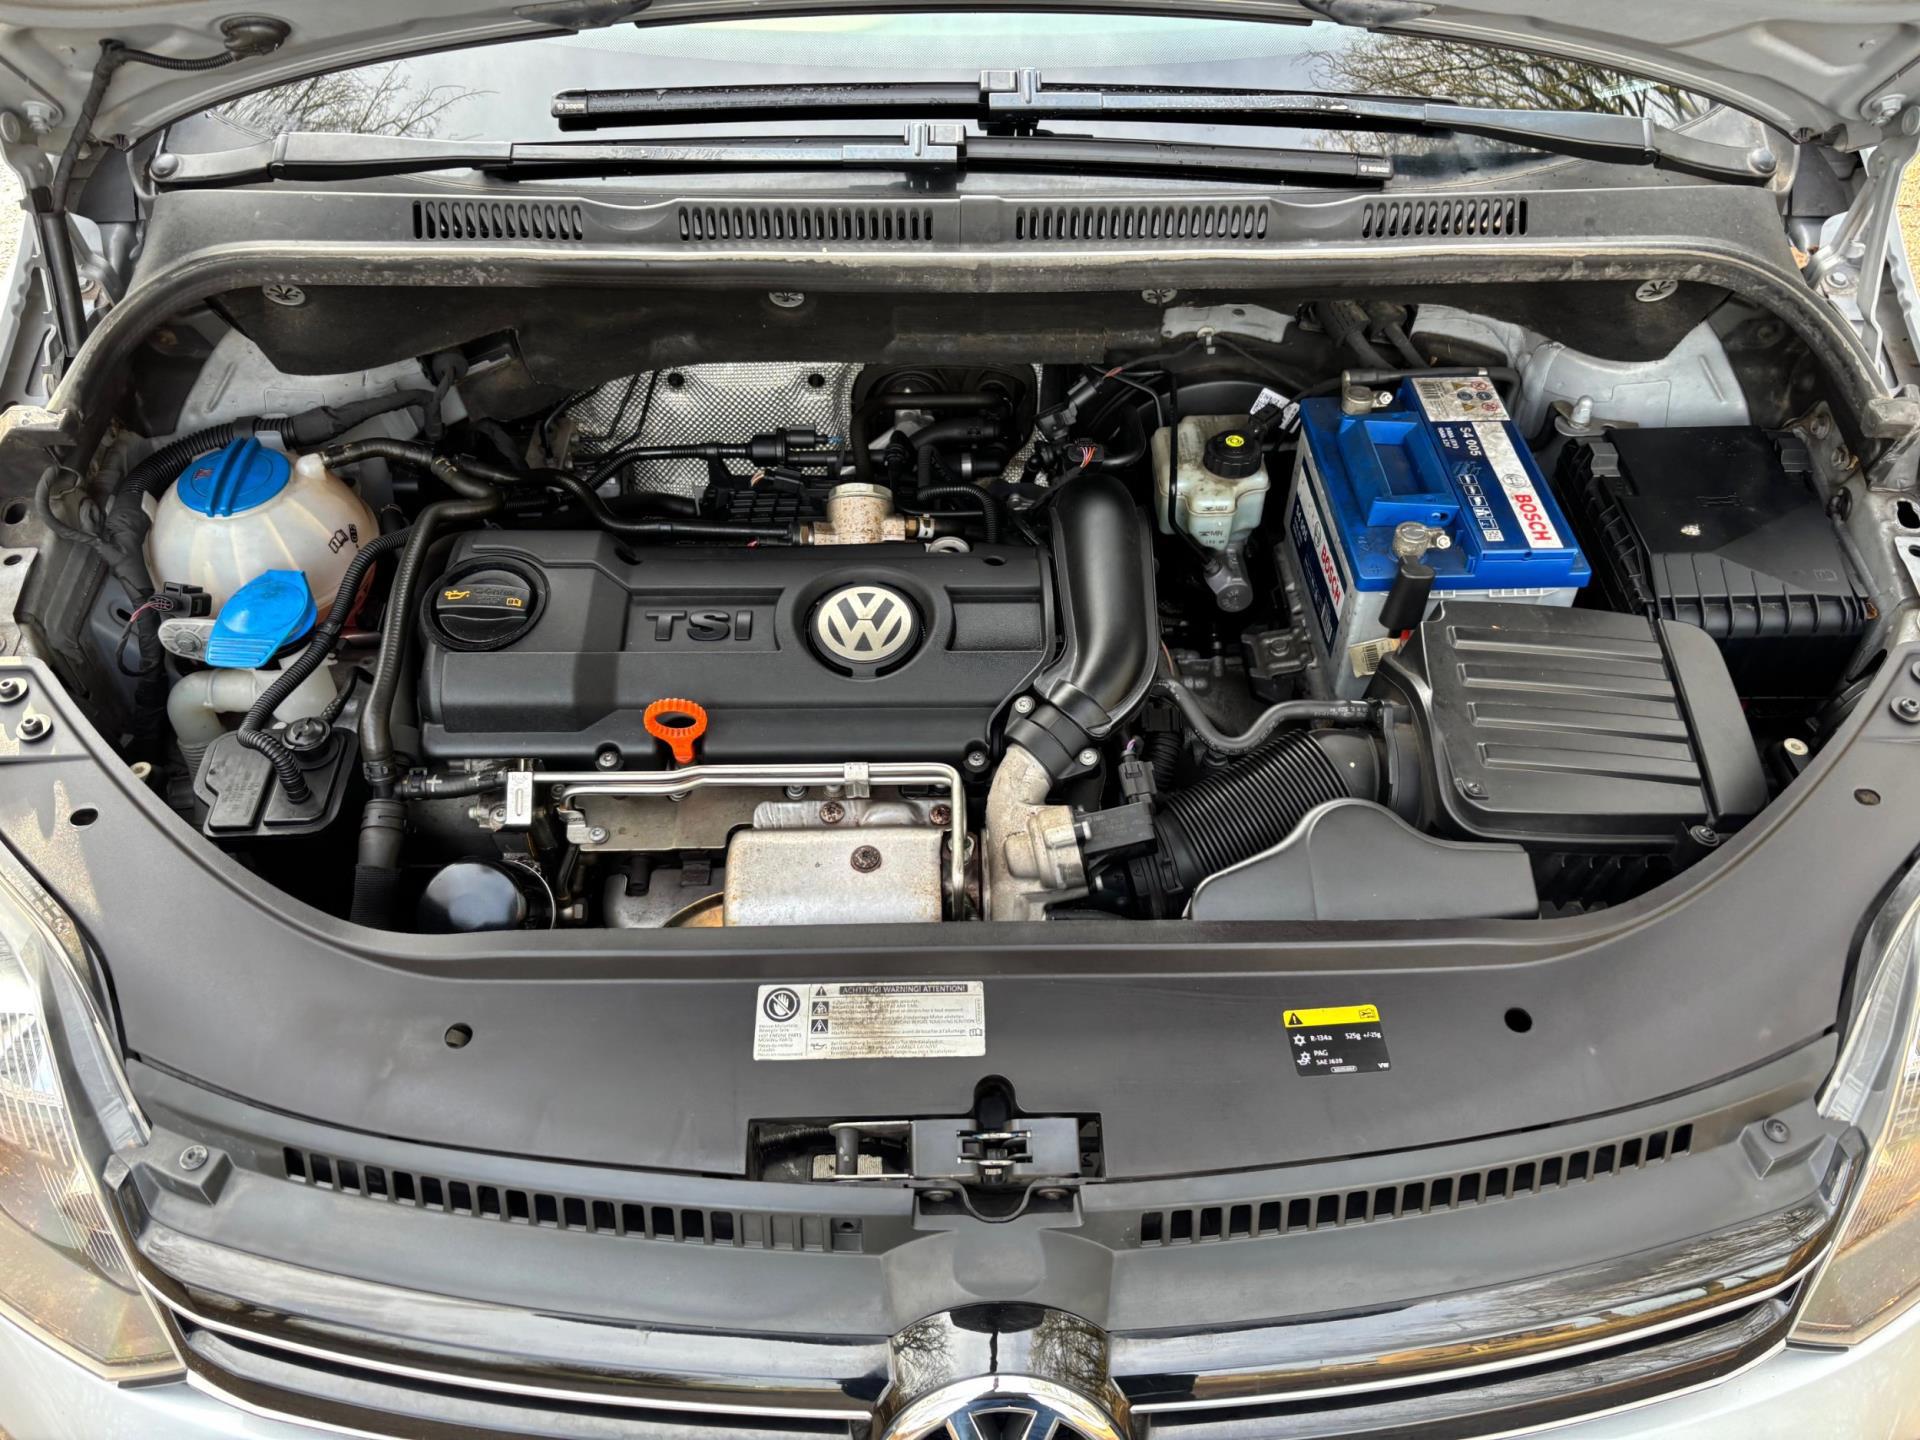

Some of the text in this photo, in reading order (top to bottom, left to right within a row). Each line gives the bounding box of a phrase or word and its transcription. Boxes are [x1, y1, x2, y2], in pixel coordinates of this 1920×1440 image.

[1460, 426, 1482, 457] S4 005
[1515, 494, 1552, 541] BOSCH
[1321, 544, 1341, 606] BOSCH
[645, 609, 753, 641] TSI
[842, 984, 966, 994] ACHTUNG! WARNING! ATTENTION!
[1310, 1034, 1333, 1042] R-134a
[1345, 1032, 1362, 1041] 525g
[1313, 1049, 1329, 1057] PAG
